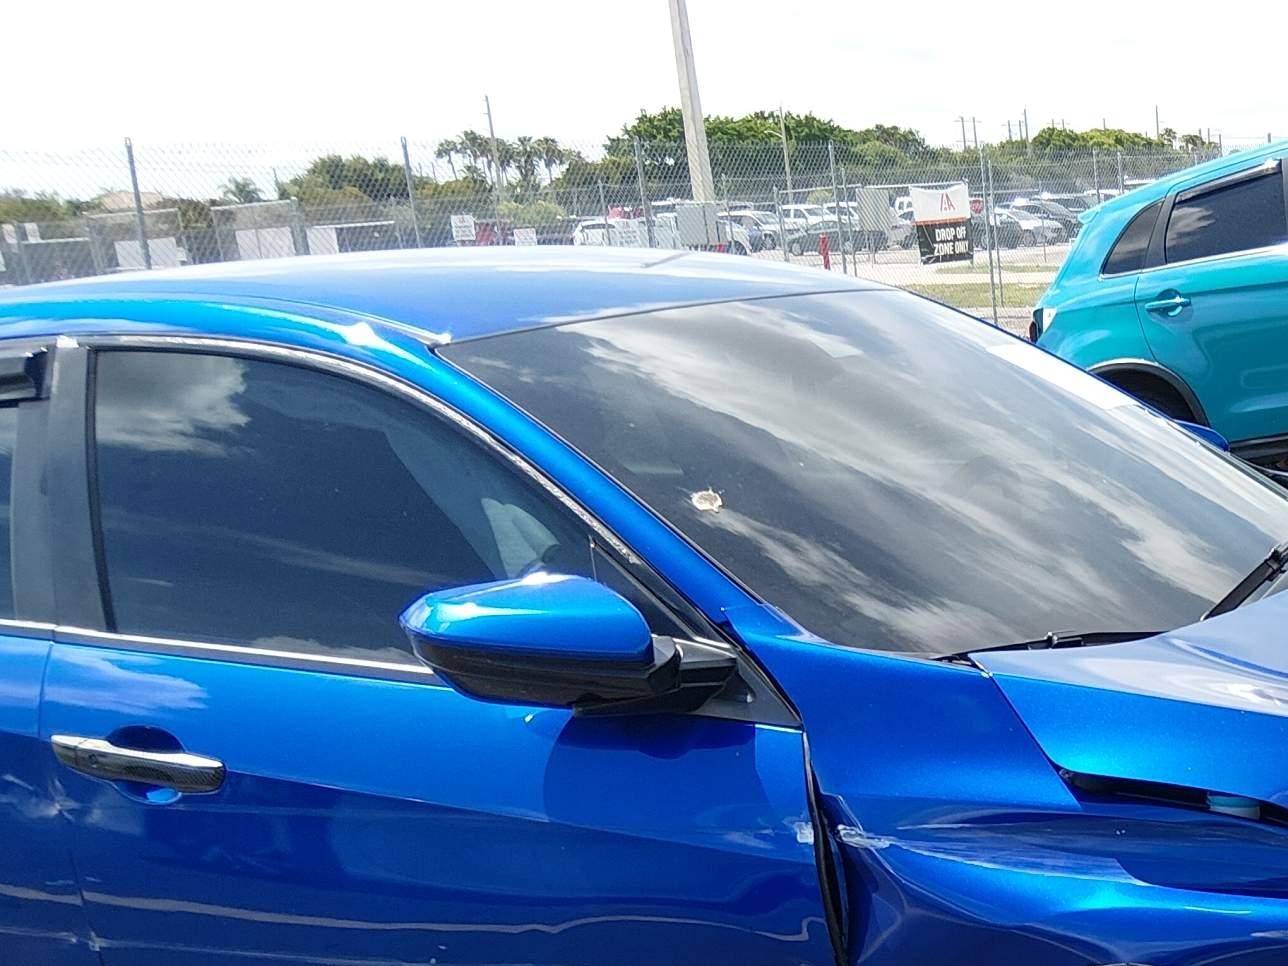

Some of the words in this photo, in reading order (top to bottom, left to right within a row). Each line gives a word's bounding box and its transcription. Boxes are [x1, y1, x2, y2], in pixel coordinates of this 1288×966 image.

[935, 228, 955, 241] DROP
[956, 226, 966, 239] OFF
[933, 242, 953, 256] ZONE
[954, 239, 969, 253] ONLY
